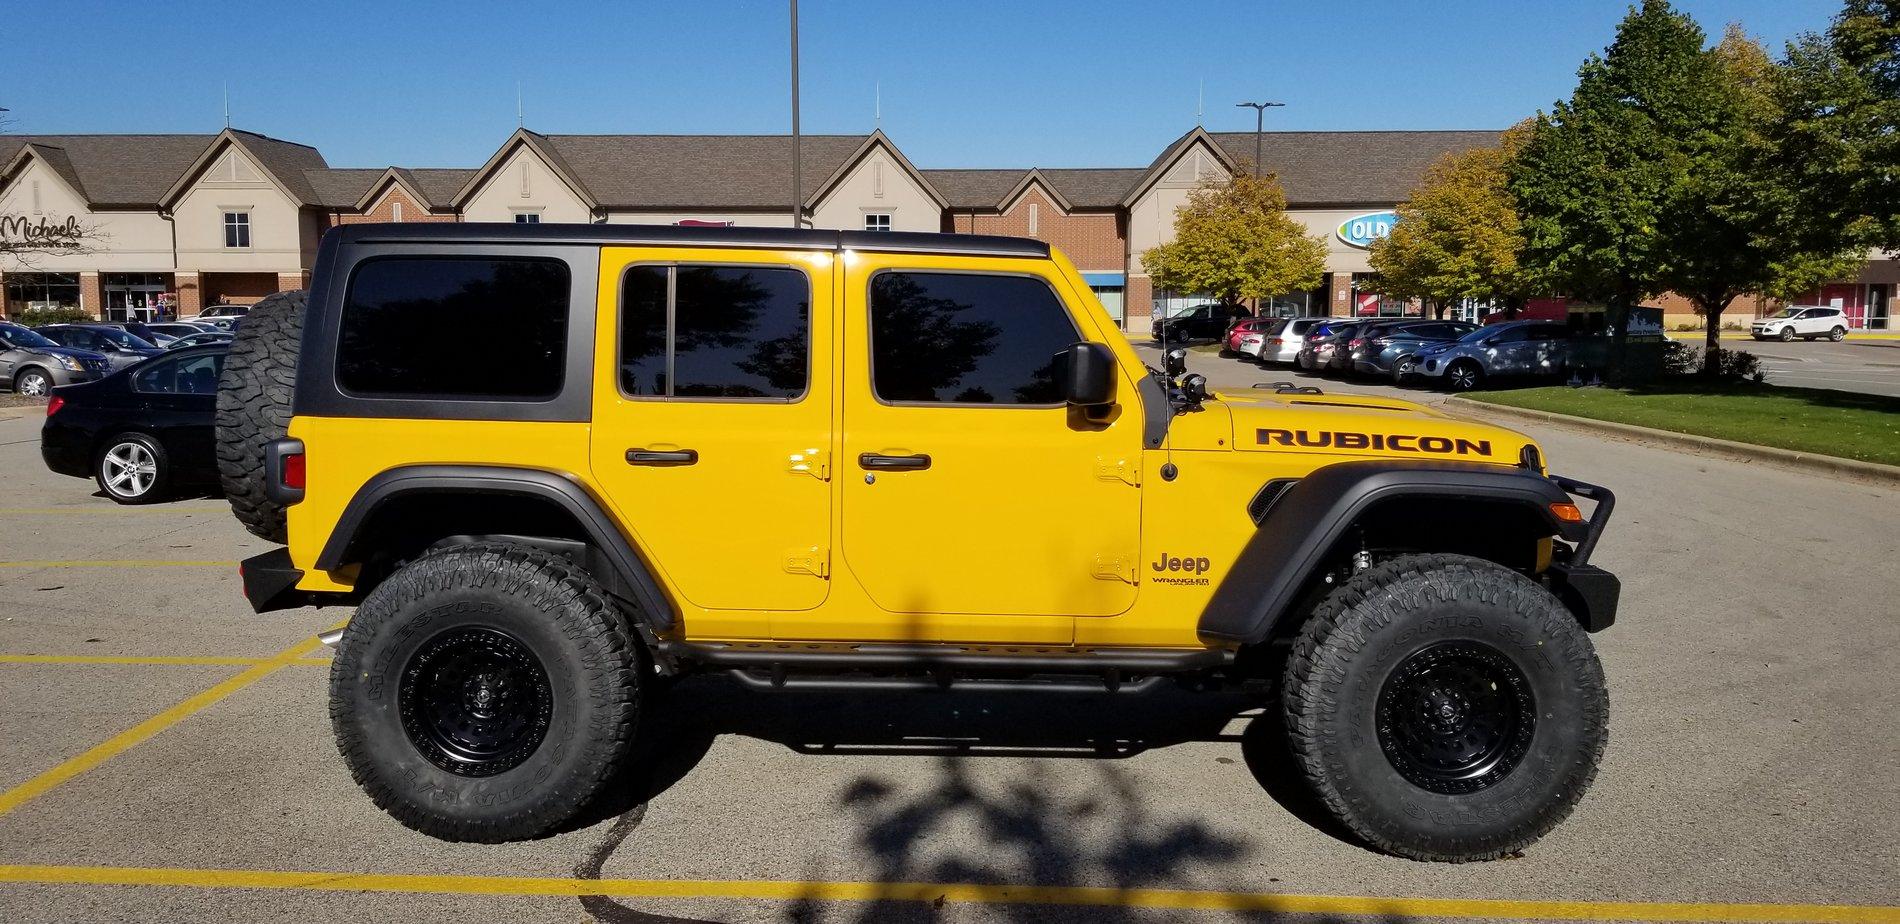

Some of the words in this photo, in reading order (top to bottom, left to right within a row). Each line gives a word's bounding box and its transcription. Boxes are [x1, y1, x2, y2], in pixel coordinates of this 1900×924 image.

[0, 215, 82, 242] Michaels
[1352, 222, 1389, 239] OLD
[1256, 428, 1492, 456] RUBICON
[1152, 552, 1210, 575] Jeep
